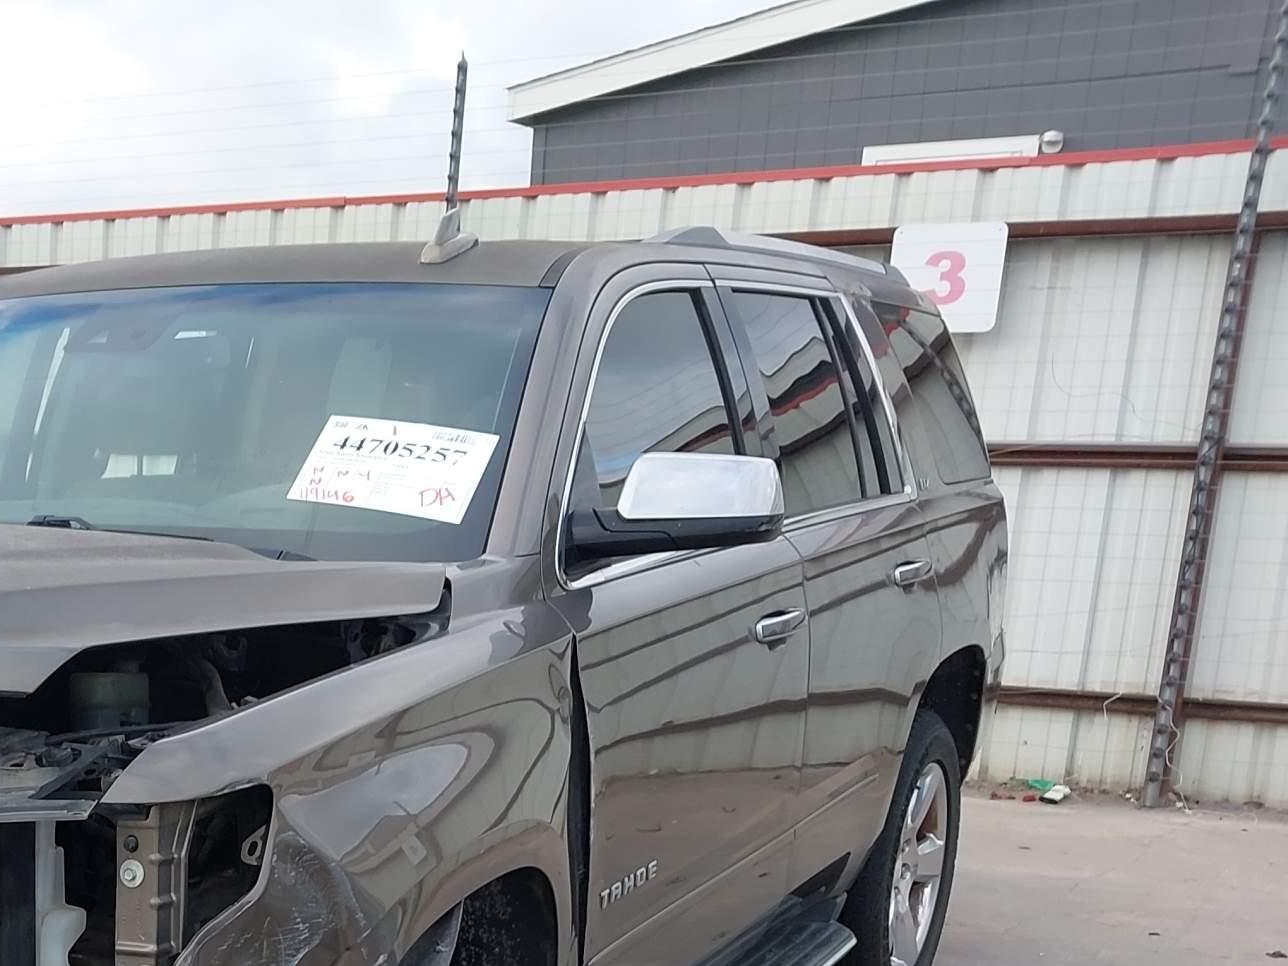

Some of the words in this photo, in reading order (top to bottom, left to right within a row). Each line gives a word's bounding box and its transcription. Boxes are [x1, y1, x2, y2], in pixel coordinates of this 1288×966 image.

[925, 251, 966, 305] 3
[332, 434, 468, 467] 44705257
[600, 859, 658, 910] TAHOE
